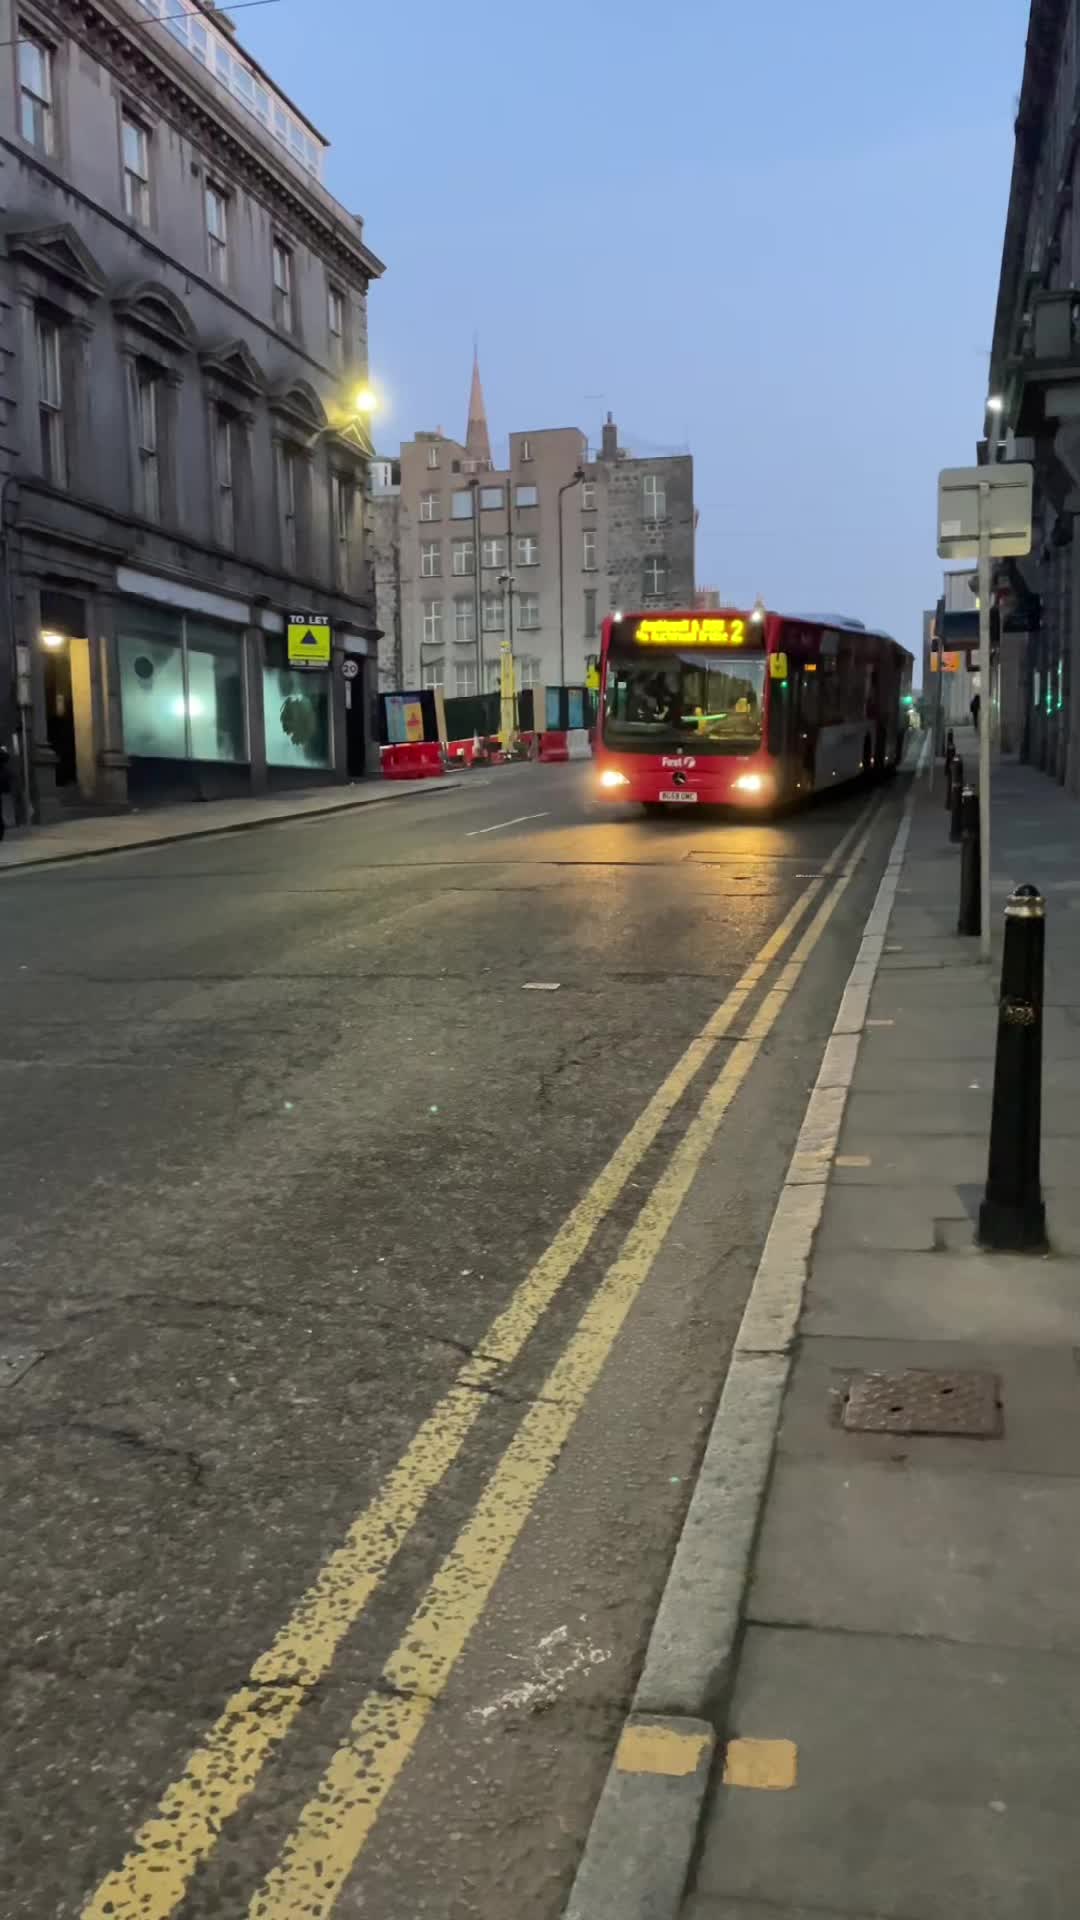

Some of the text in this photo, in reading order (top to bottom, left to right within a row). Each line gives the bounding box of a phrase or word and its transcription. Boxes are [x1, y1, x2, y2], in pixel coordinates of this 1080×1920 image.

[290, 615, 328, 625] TO LET
[730, 619, 744, 643] 2
[343, 664, 357, 674] 20
[662, 756, 683, 768] First
